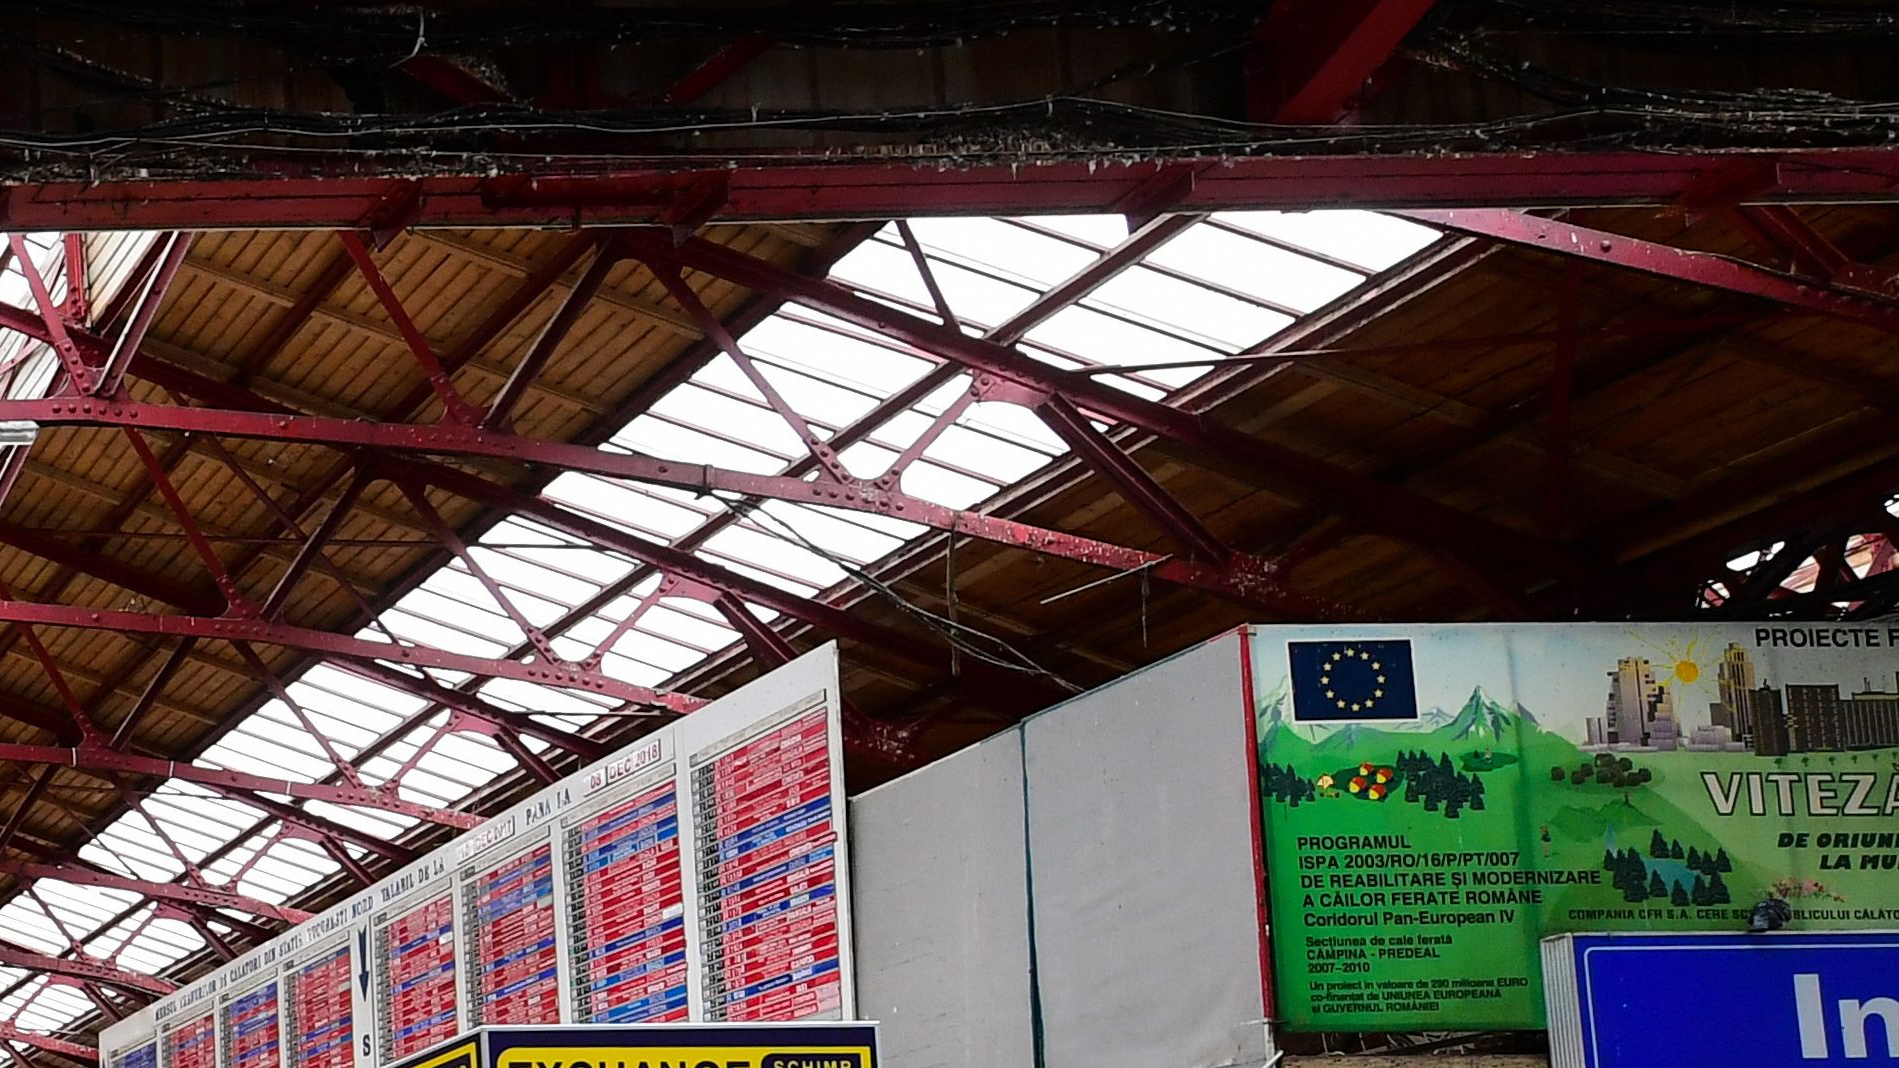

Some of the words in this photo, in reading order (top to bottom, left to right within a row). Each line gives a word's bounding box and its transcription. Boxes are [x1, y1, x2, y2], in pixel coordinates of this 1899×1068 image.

[1755, 628, 1880, 647] PROIECTE
[609, 761, 632, 781] DEC
[1297, 835, 1411, 850] PROGRAMUL
[1778, 833, 1810, 848] DE
[1816, 833, 1899, 848] ORIUN
[1299, 855, 1339, 869] ISPA
[1344, 852, 1519, 869] 2003/RO/16/P/PT/007
[1820, 855, 1851, 870] LA
[1859, 855, 1899, 870] MU
[1301, 875, 1325, 888] DE
[1330, 872, 1445, 888] REABILITARE
[1451, 871, 1469, 888] ȘI
[1472, 871, 1601, 885] MODERNIZARE
[1303, 894, 1315, 908] A
[1320, 890, 1386, 907] CĂILOR
[1391, 891, 1461, 906] FERATE
[1465, 887, 1542, 905] ROMÂNE
[1304, 910, 1378, 927] Coridorul
[1383, 910, 1496, 927] Pan-European
[1500, 910, 1515, 924] IV
[1568, 909, 1635, 920] COMPANIA
[1638, 909, 1663, 920] CFR
[1667, 908, 1692, 920] S.A.
[1696, 908, 1728, 920] CERE
[1792, 909, 1850, 920] BLICULUI
[1369, 935, 1385, 946] de
[1389, 935, 1414, 946] cale
[1379, 947, 1440, 959] PREDEAL
[1310, 981, 1324, 991] Un
[1326, 981, 1362, 992] proiect
[1416, 979, 1429, 989] de
[1497, 977, 1529, 987] EURO
[1366, 991, 1379, 1001] de
[1382, 990, 1430, 1000] UNIUNEA
[1323, 1003, 1383, 1014] GUVERNUL
[1793, 973, 1899, 1060] In
